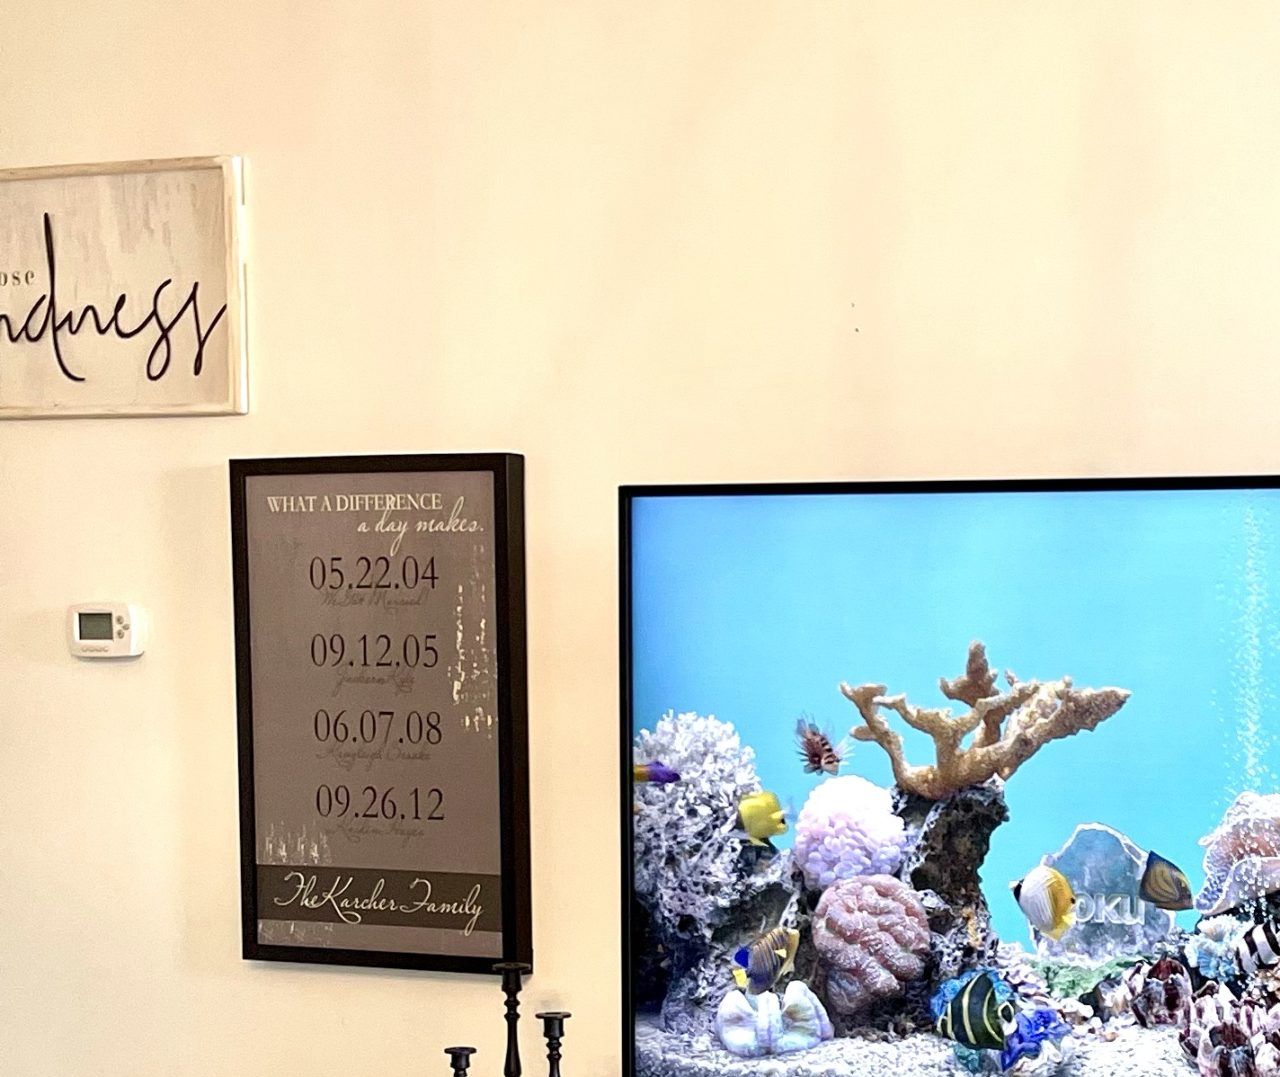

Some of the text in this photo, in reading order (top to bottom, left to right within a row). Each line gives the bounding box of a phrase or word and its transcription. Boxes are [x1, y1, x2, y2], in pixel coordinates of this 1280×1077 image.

[267, 493, 443, 513] WHAT A DIFFERENCE
[357, 496, 484, 556] a day makes.
[309, 556, 439, 590] 05.22.04
[311, 633, 438, 668] 09.12.05
[314, 709, 442, 745] 06.07.08
[316, 784, 445, 820] 09.26.12
[274, 871, 484, 936] The Karcher Family
